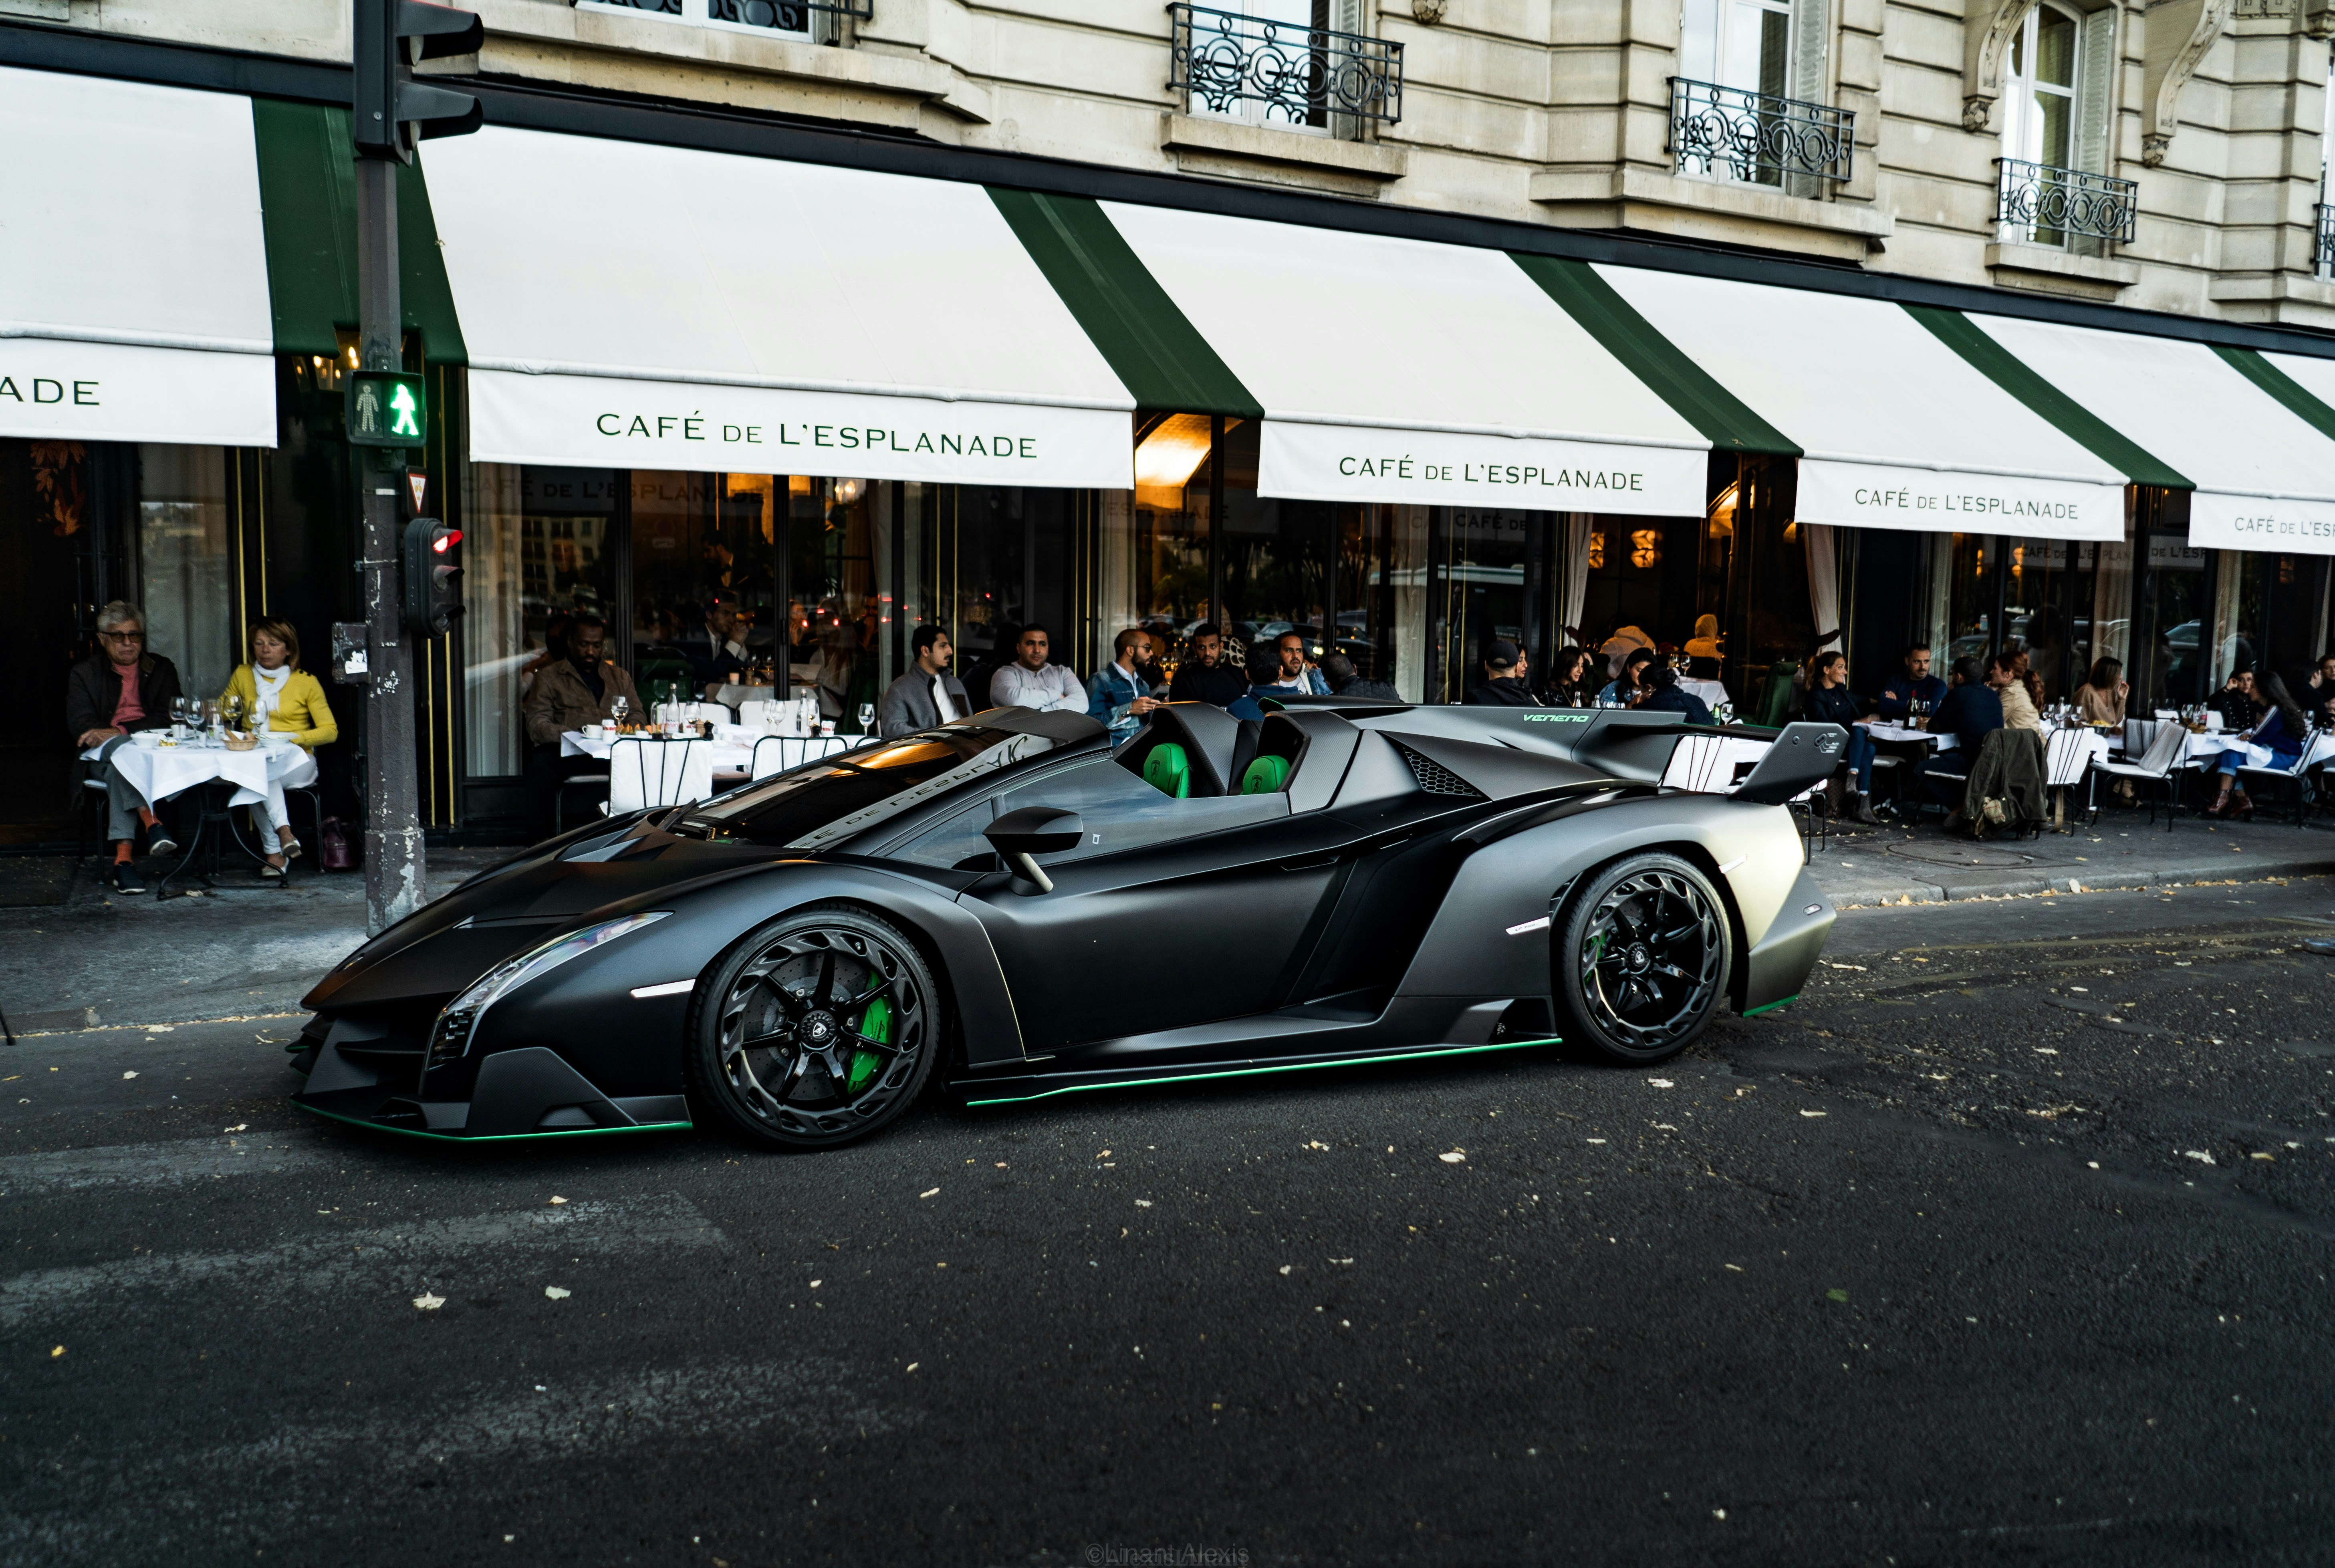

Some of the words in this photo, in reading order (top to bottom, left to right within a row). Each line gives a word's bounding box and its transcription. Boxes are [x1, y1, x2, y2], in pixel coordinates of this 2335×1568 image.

[597, 411, 705, 440] CAFÉ
[724, 425, 762, 443] DE
[781, 424, 1037, 458] L'ESPLANADE
[1340, 455, 1414, 479] CAFÉ
[1426, 466, 1453, 481] DE
[1465, 464, 1643, 491] L'ESPLANADE
[544, 484, 573, 498] DE
[1855, 488, 1909, 508] CAFÉ
[1918, 496, 1937, 509] DE
[1946, 495, 2078, 520] L'ESPLANADE
[2235, 516, 2274, 533] CAFÉ
[2280, 523, 2295, 534] DE
